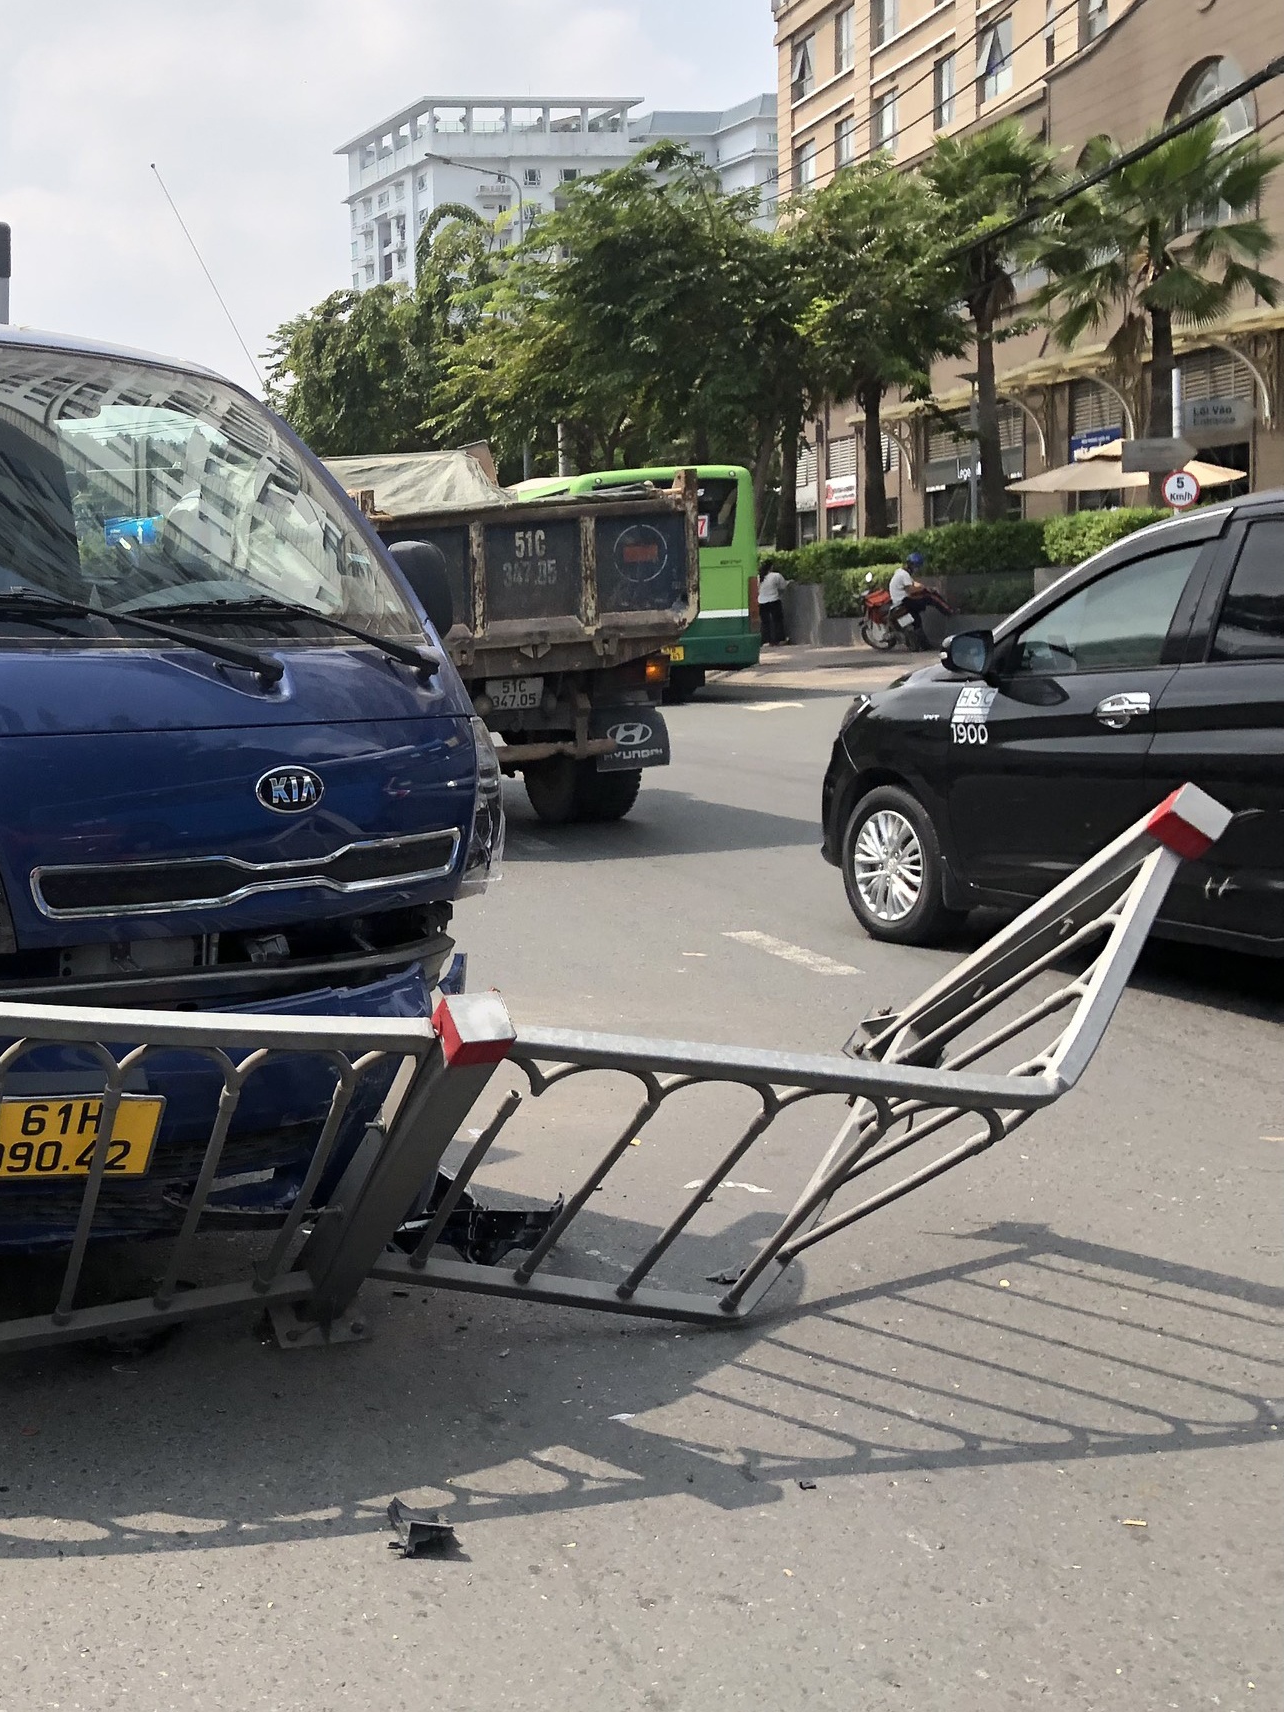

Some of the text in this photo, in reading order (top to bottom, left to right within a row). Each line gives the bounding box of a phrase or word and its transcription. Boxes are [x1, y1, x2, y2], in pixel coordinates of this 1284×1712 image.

[1176, 476, 1185, 489] 5
[1170, 491, 1193, 501] Km/h
[514, 529, 546, 558] 51C
[502, 680, 527, 694] 51C
[492, 692, 536, 707] 347.05
[958, 689, 996, 705] HSC
[950, 723, 989, 745] 1900
[269, 775, 317, 804] KIA
[21, 1102, 105, 1136] 61H
